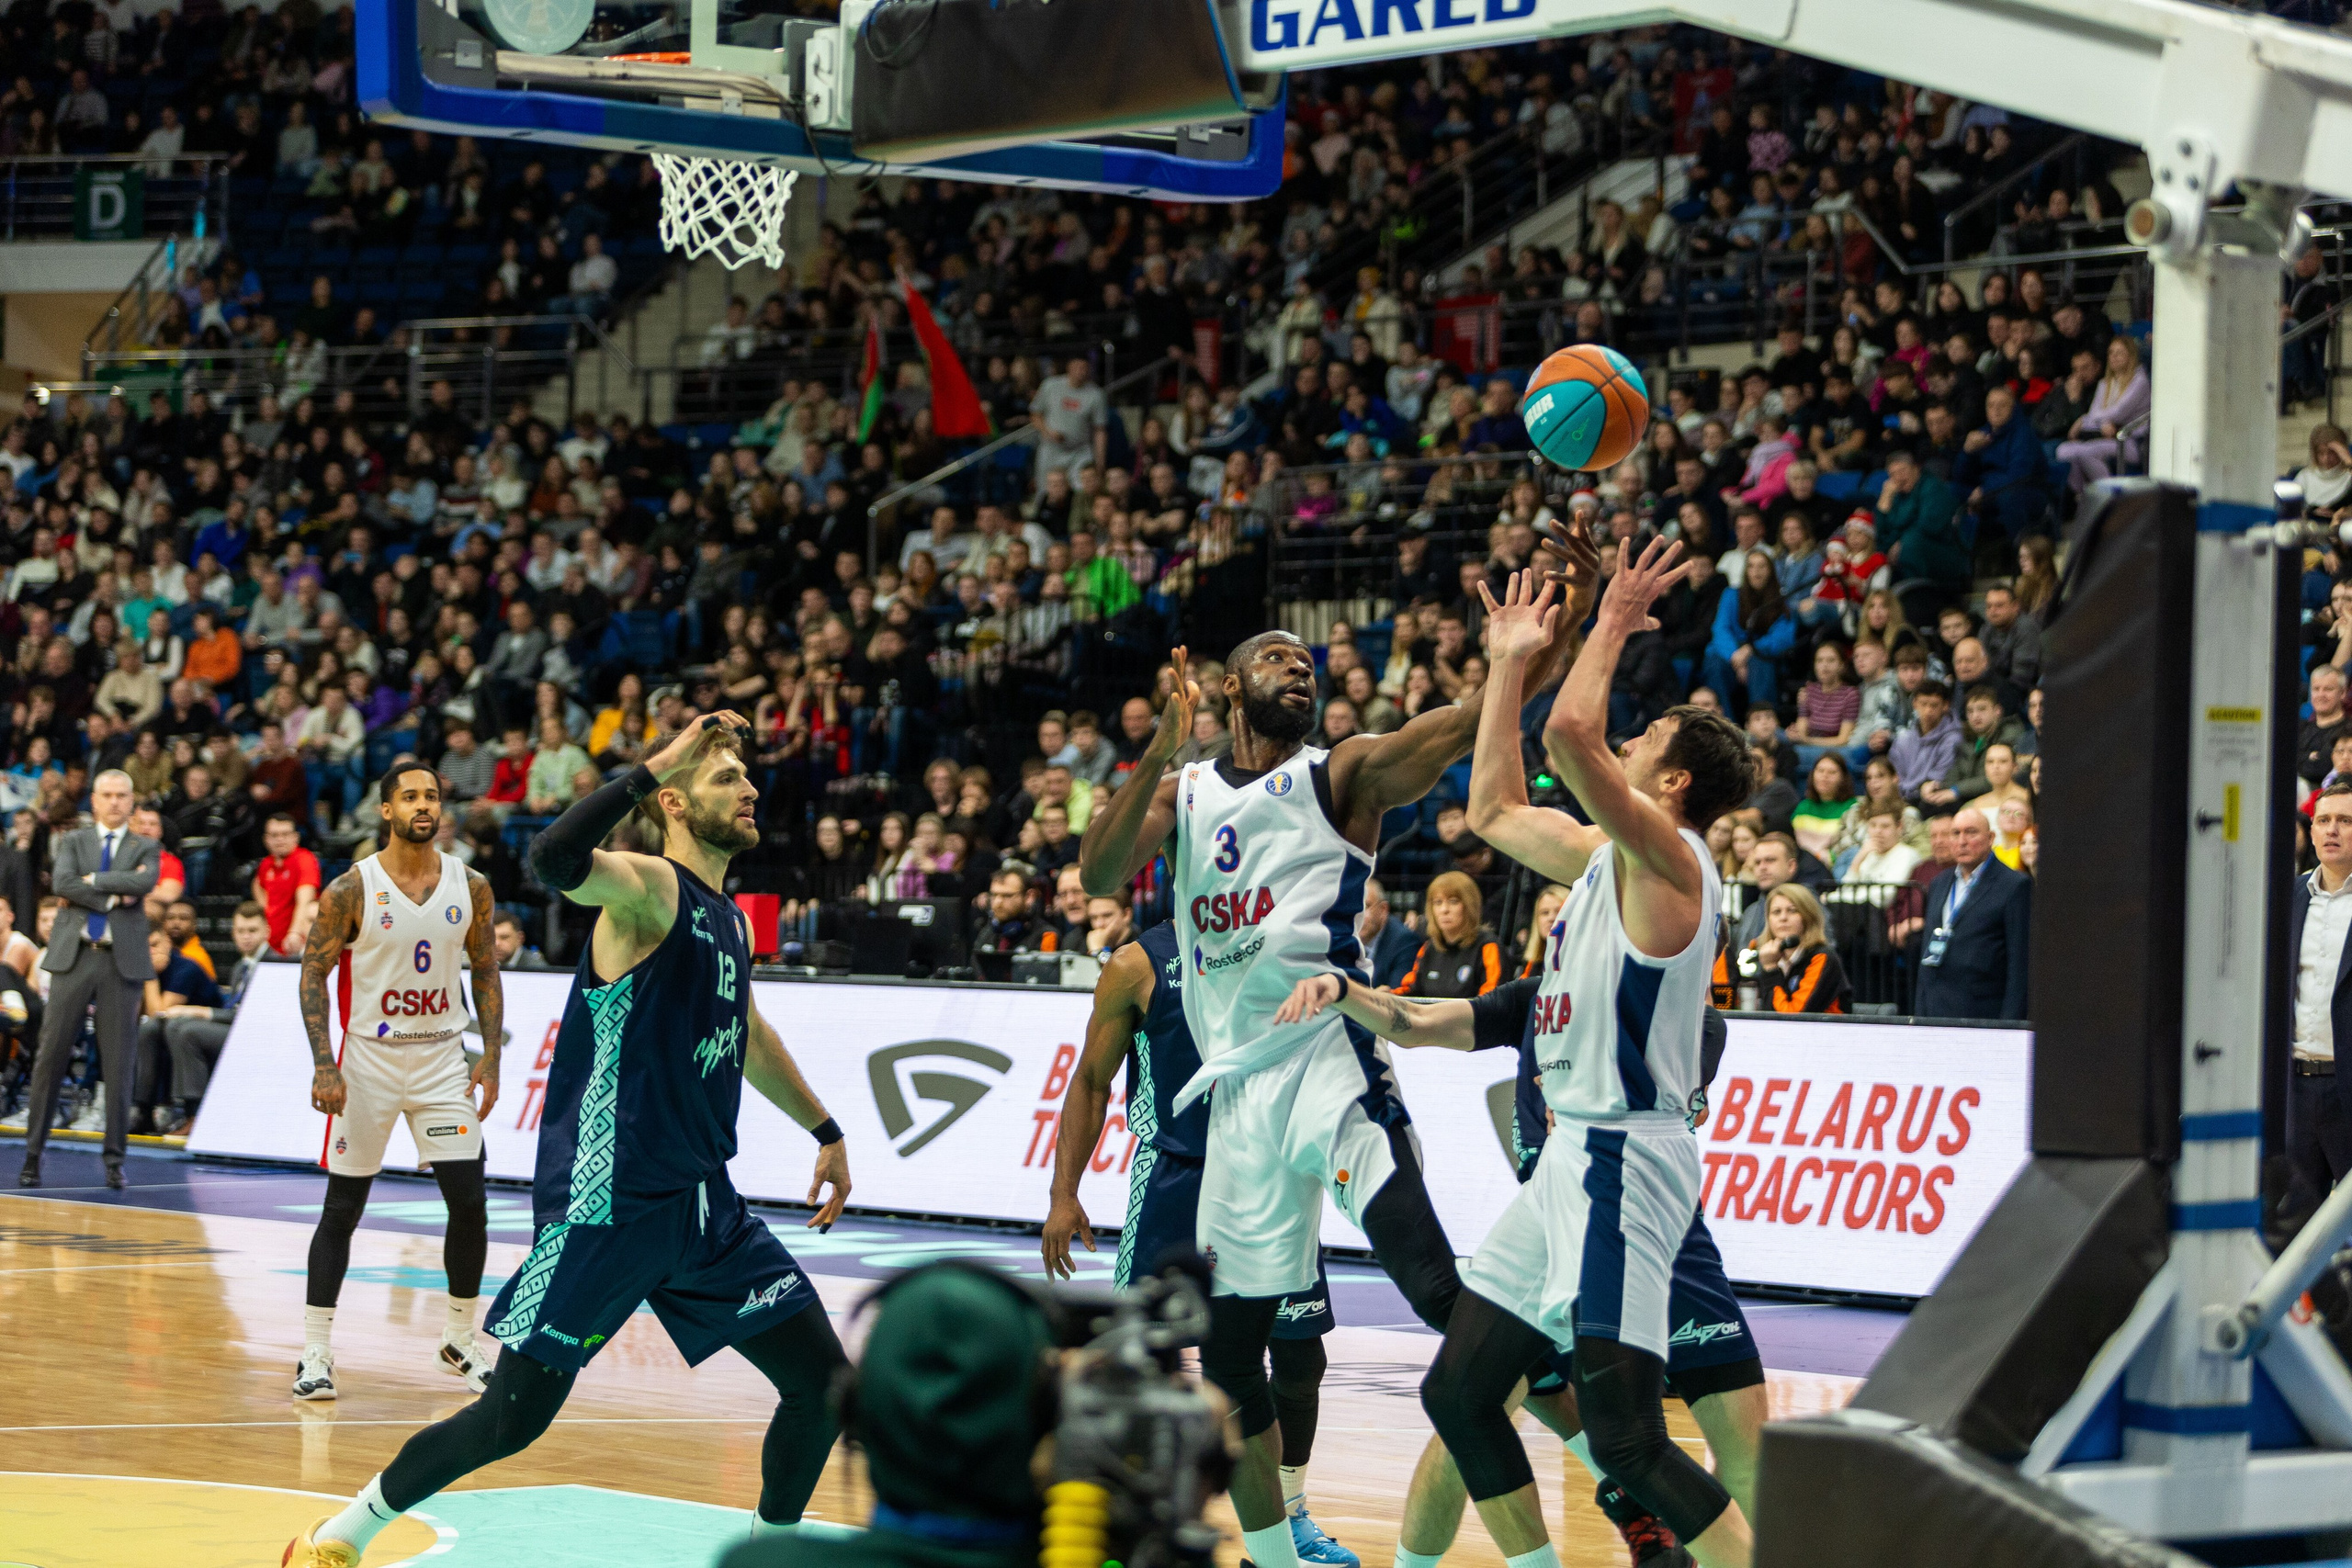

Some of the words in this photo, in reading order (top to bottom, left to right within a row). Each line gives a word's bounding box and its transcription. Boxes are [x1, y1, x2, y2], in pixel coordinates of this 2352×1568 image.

[1215, 824, 1240, 874] 3
[1190, 886, 1276, 934] CSKA
[413, 939, 433, 974] 6
[717, 950, 737, 1002] 12
[380, 987, 450, 1017] CSKA
[1534, 992, 1572, 1037] SKA
[393, 1028, 454, 1040] Rostelecom
[1710, 1076, 1981, 1156] BELARUS
[1701, 1151, 1955, 1235] TRACTORS
[540, 1323, 580, 1347] Kempa
